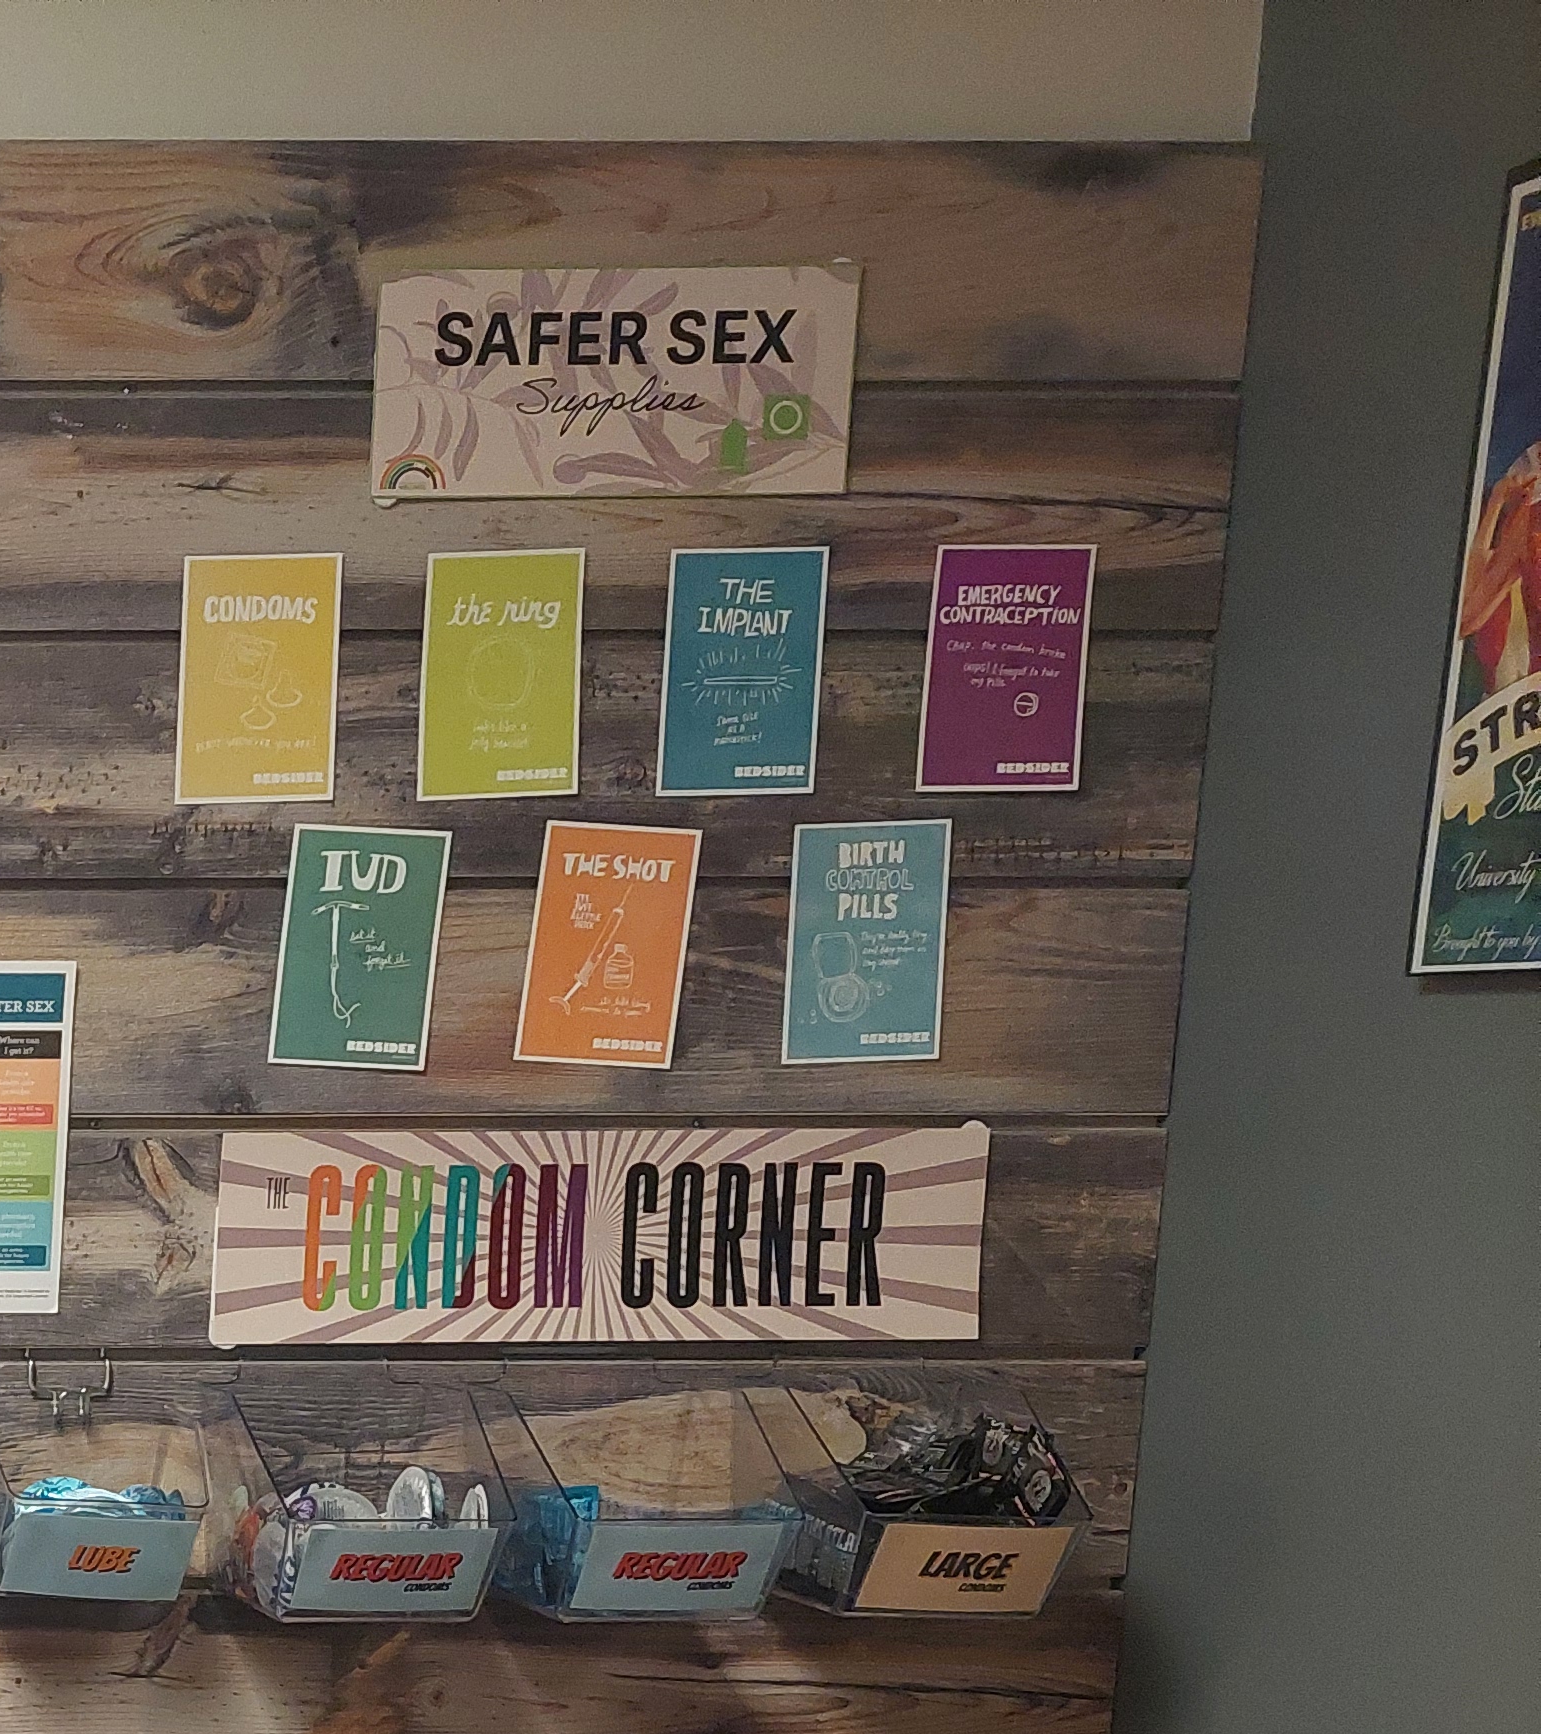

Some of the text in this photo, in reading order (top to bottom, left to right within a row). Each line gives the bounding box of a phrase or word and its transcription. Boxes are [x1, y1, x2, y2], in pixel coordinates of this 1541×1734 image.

[434, 309, 798, 367] SAFER SEX
[517, 377, 707, 437] Supplies
[719, 578, 775, 604] THE
[958, 584, 1062, 606] EMERGENCY
[203, 595, 318, 624] CONDOMS
[697, 607, 792, 638] IMPLANT
[939, 606, 1081, 626] CONTRACEPTION
[563, 852, 675, 883] THE SHOT
[839, 840, 905, 869] BIRTH
[320, 850, 407, 894] IUD
[826, 868, 914, 891] CONTROL
[837, 893, 899, 921] PILLS
[25, 1000, 55, 1013] SEX
[302, 1161, 886, 1312] CONDOM CORNER
[67, 1544, 140, 1573] LUBE
[329, 1553, 463, 1582] REGULAR
[612, 1551, 748, 1581] REGULAR
[919, 1551, 1019, 1580] LARGE
